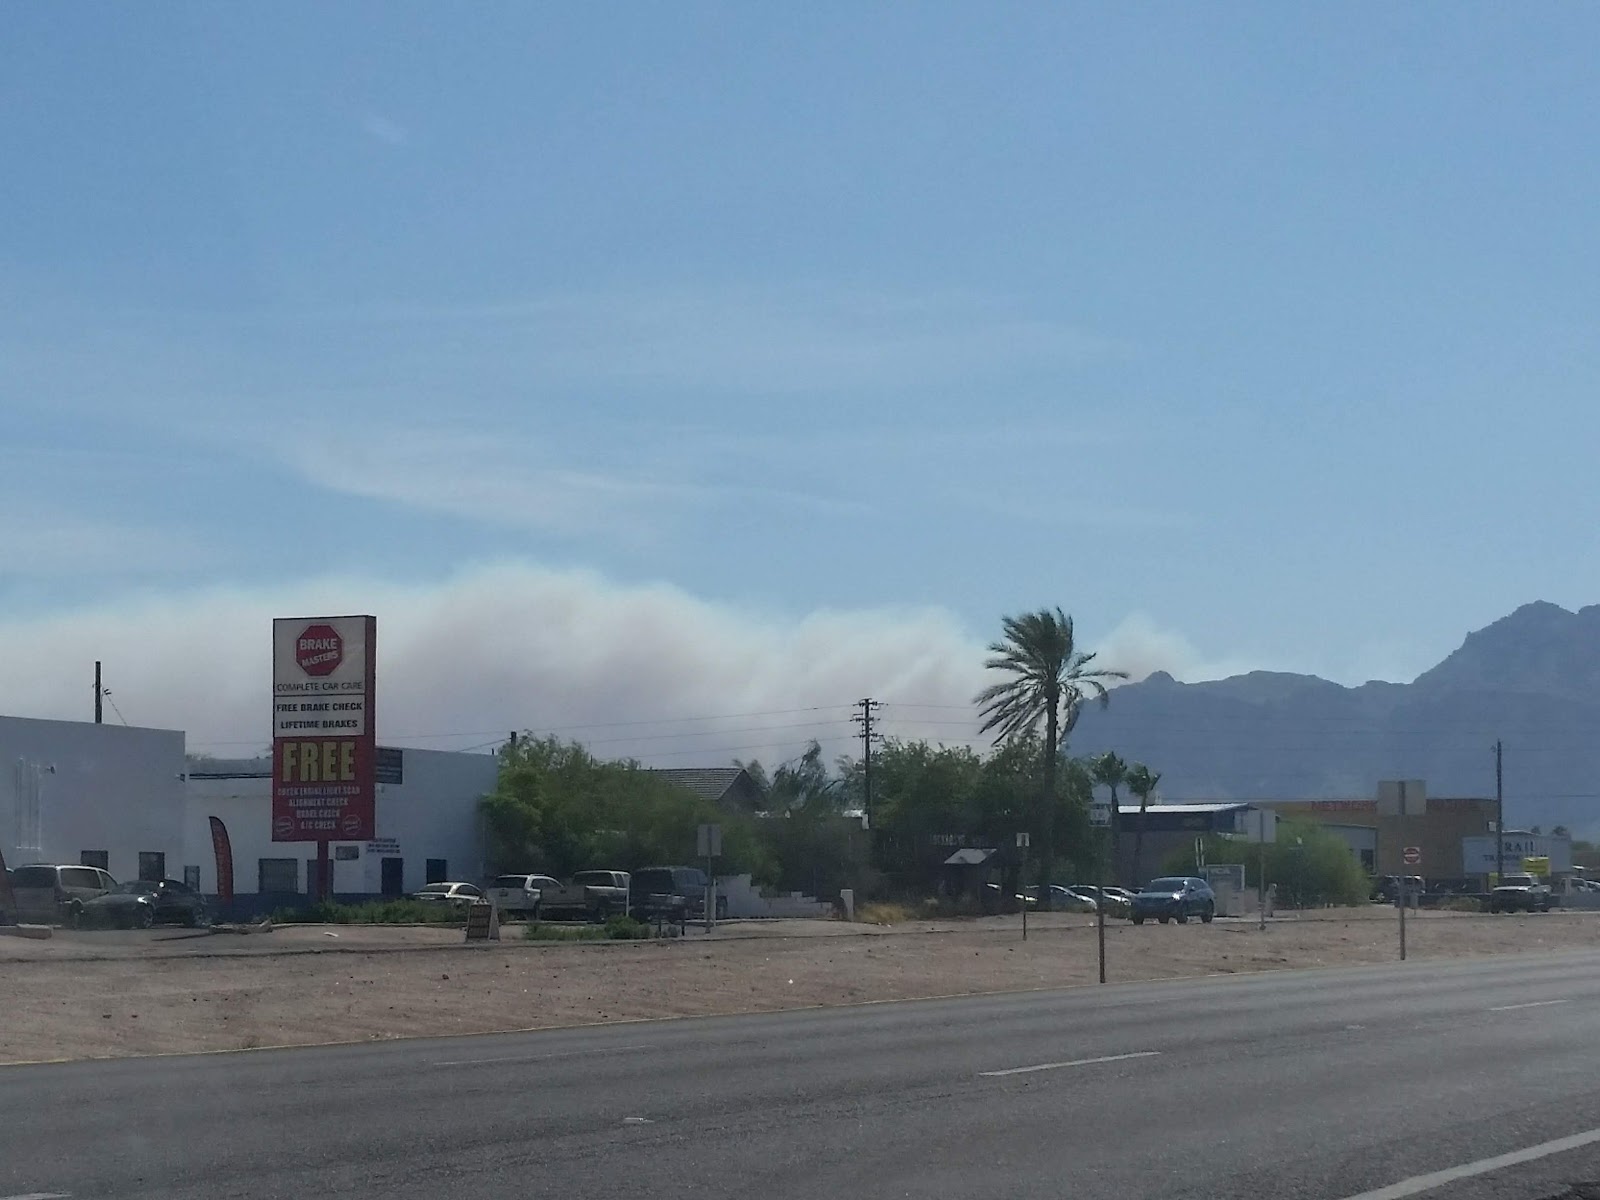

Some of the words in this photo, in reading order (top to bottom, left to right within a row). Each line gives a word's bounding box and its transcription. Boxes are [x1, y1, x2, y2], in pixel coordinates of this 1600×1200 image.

[300, 639, 337, 650] BRAKE
[302, 651, 338, 666] MASTERS
[277, 682, 319, 692] COMPLETE
[322, 682, 339, 690] CAR
[341, 681, 362, 690] CARE
[276, 703, 298, 712] FREE
[301, 703, 330, 711] BRAKE
[332, 702, 363, 711] CHECK
[280, 720, 320, 729] LIFETIME
[322, 720, 358, 728] BRAKES
[283, 742, 355, 781] FREE
